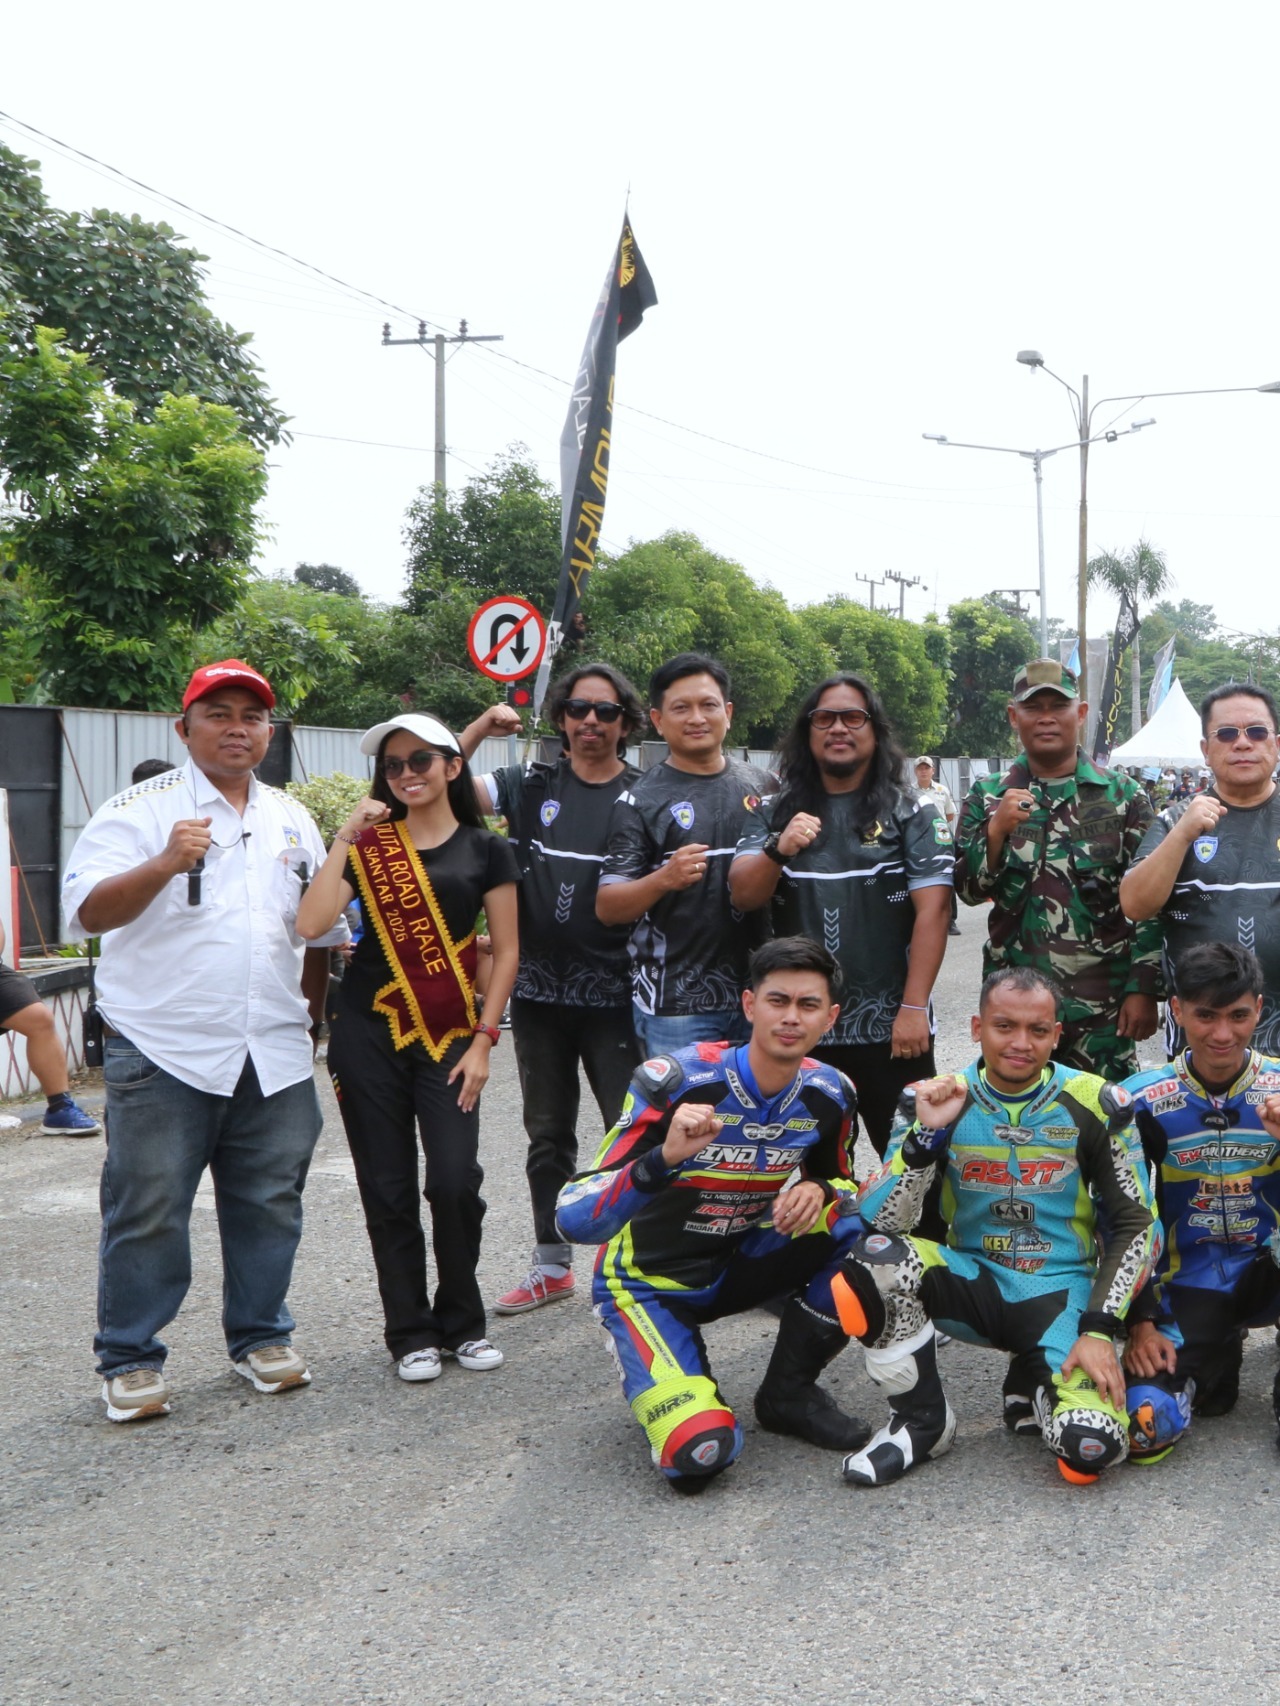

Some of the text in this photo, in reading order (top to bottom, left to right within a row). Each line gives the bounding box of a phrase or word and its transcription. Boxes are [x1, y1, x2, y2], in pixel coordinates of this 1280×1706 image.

[364, 846, 409, 943] SIANTAR 2026
[373, 822, 447, 975] DUTA ROAD RACE
[983, 1236, 1011, 1251] KEY
